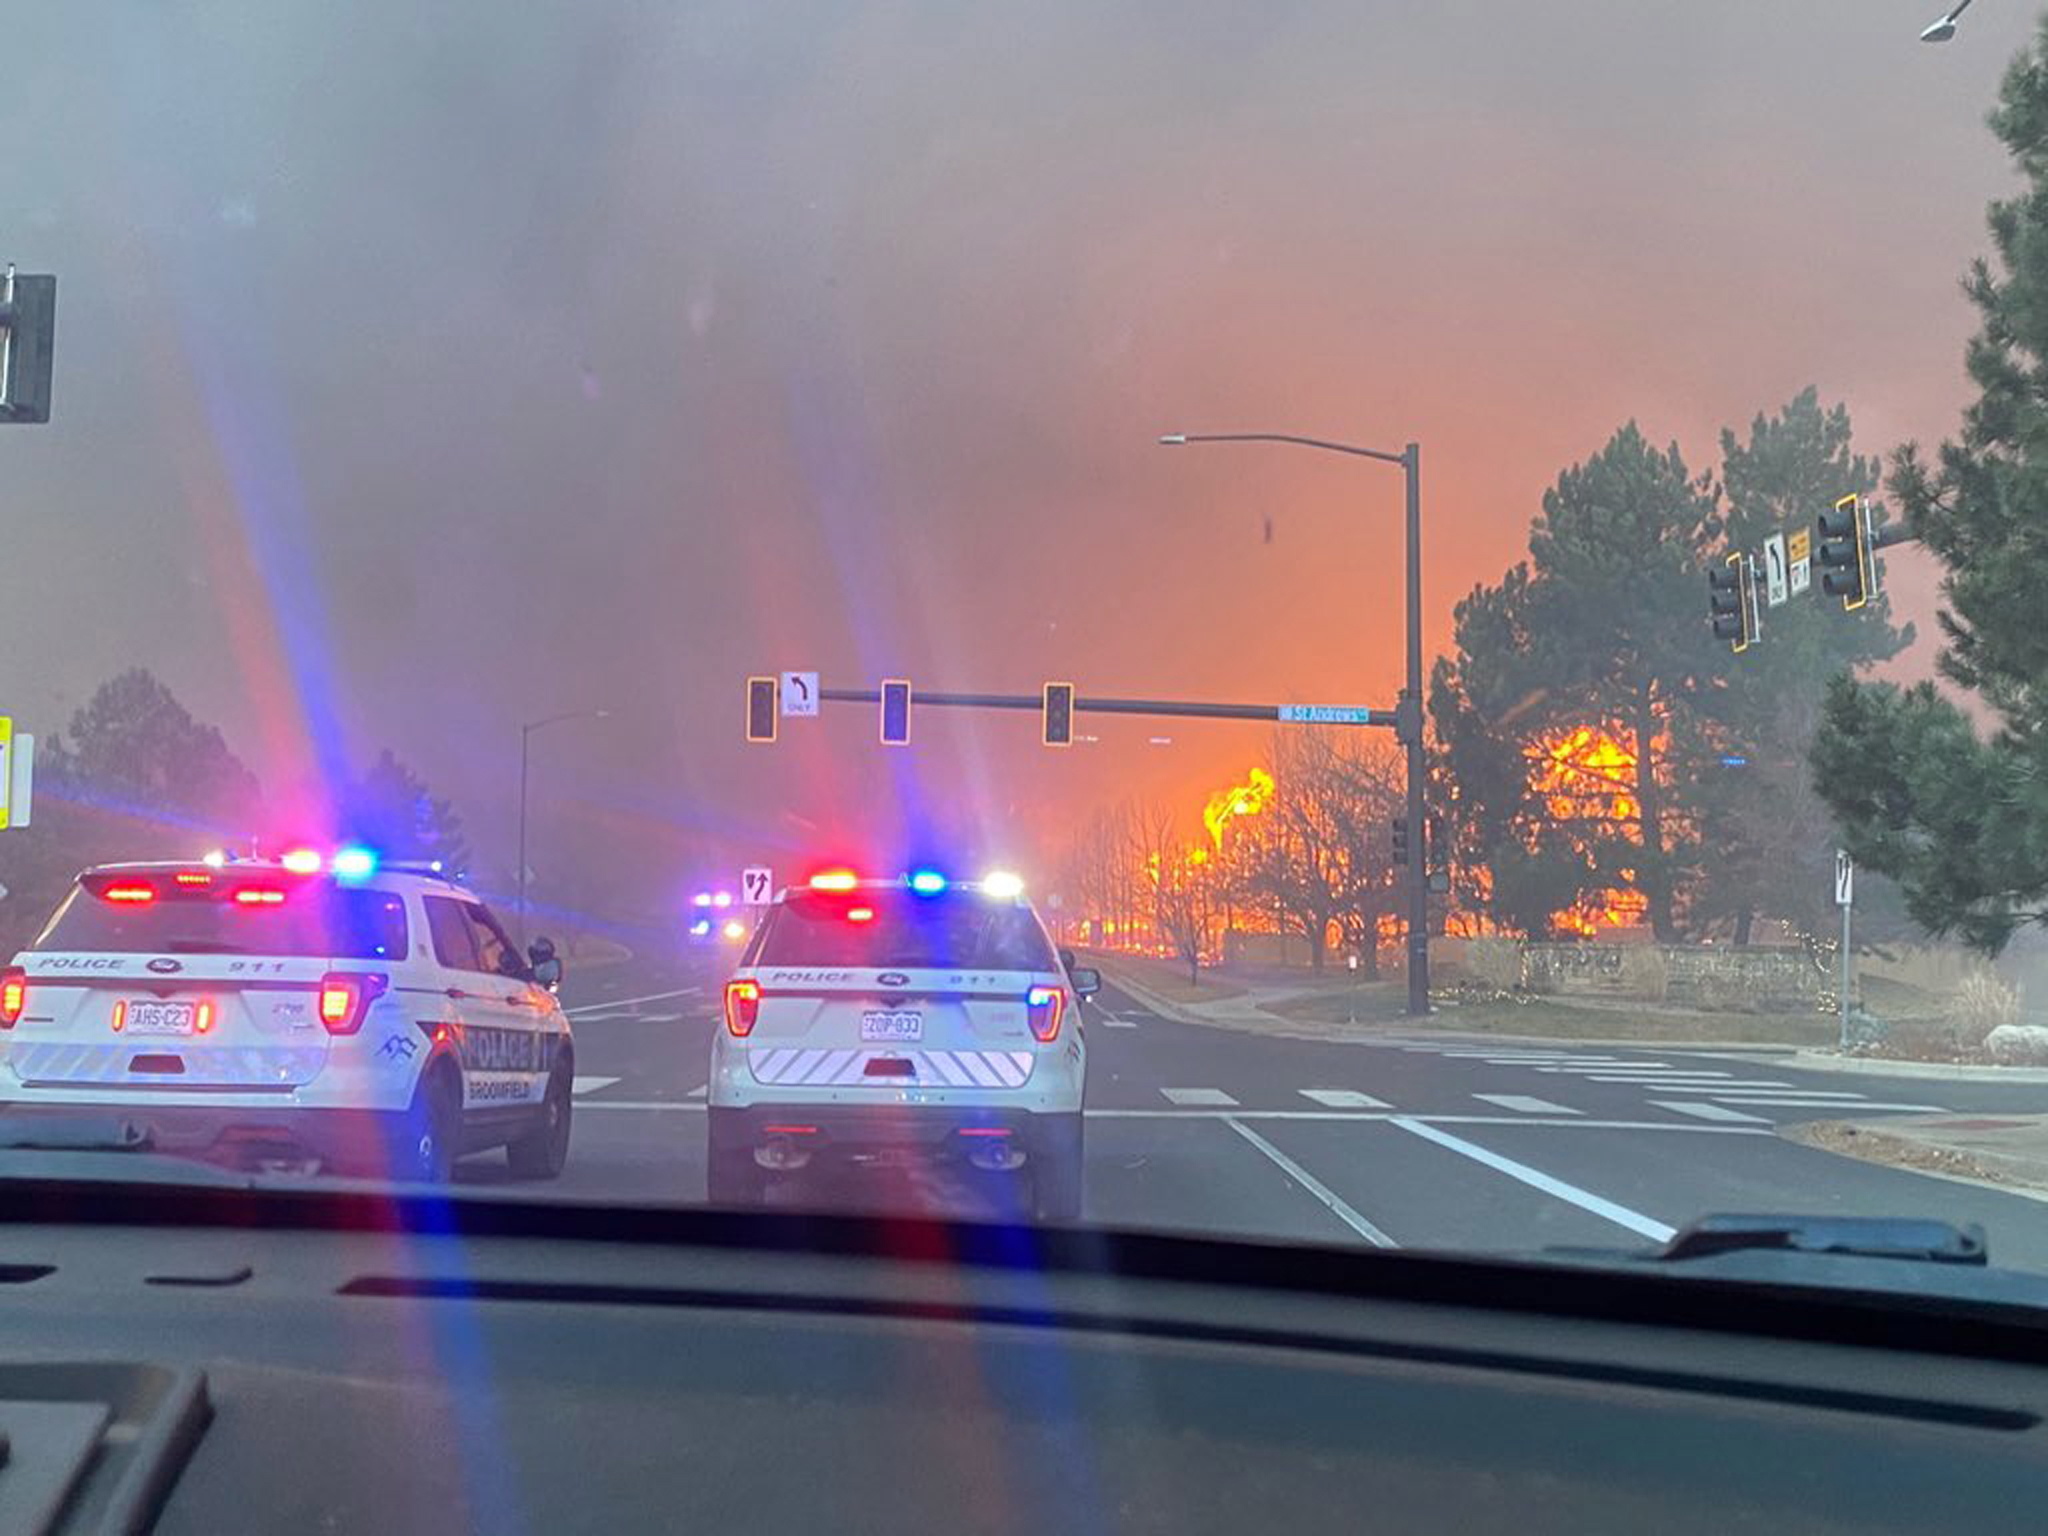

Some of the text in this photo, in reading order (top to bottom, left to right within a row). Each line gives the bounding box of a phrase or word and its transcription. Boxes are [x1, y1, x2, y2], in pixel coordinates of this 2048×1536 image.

[39, 957, 284, 973] POLICE 911
[772, 972, 857, 982] POLICE
[465, 1030, 529, 1068] POLICE
[469, 1081, 529, 1100] BROOMFIELD
